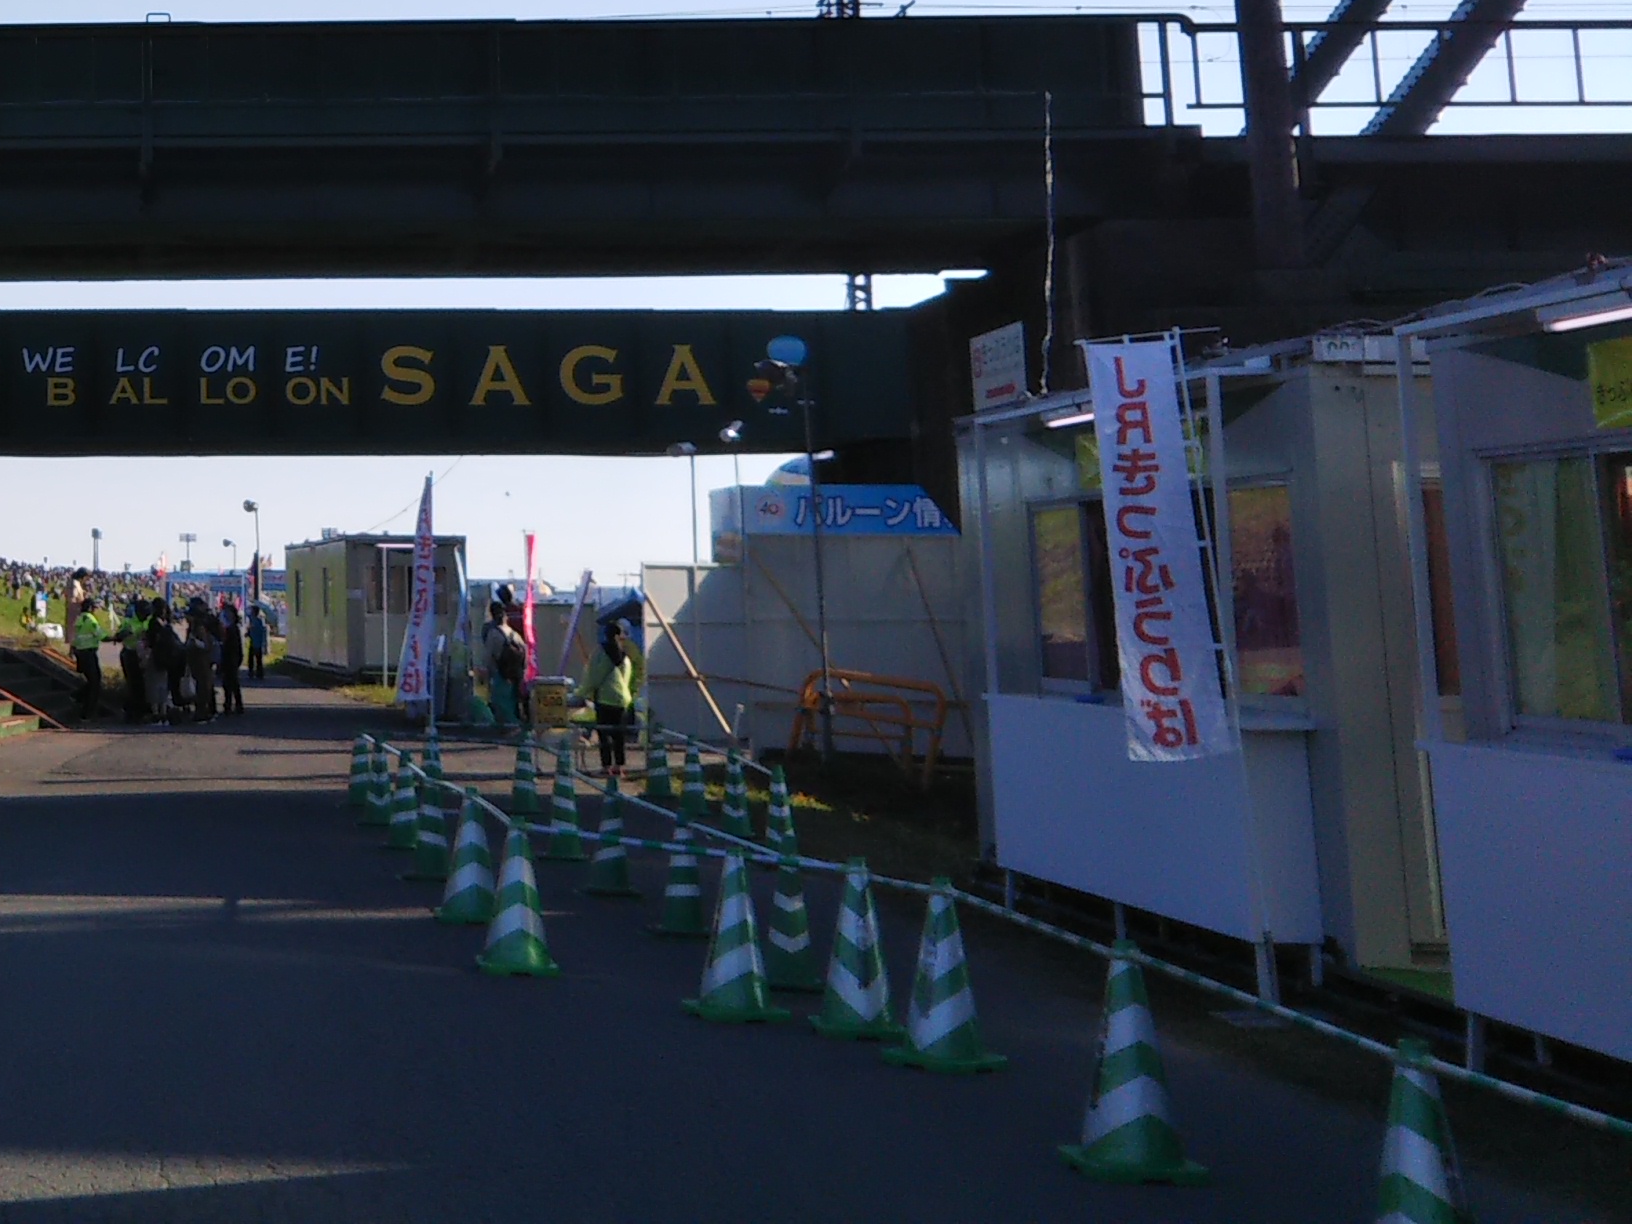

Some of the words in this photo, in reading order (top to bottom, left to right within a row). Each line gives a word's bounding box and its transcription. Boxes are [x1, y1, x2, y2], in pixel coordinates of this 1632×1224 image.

[794, 496, 954, 528] バルーン情
